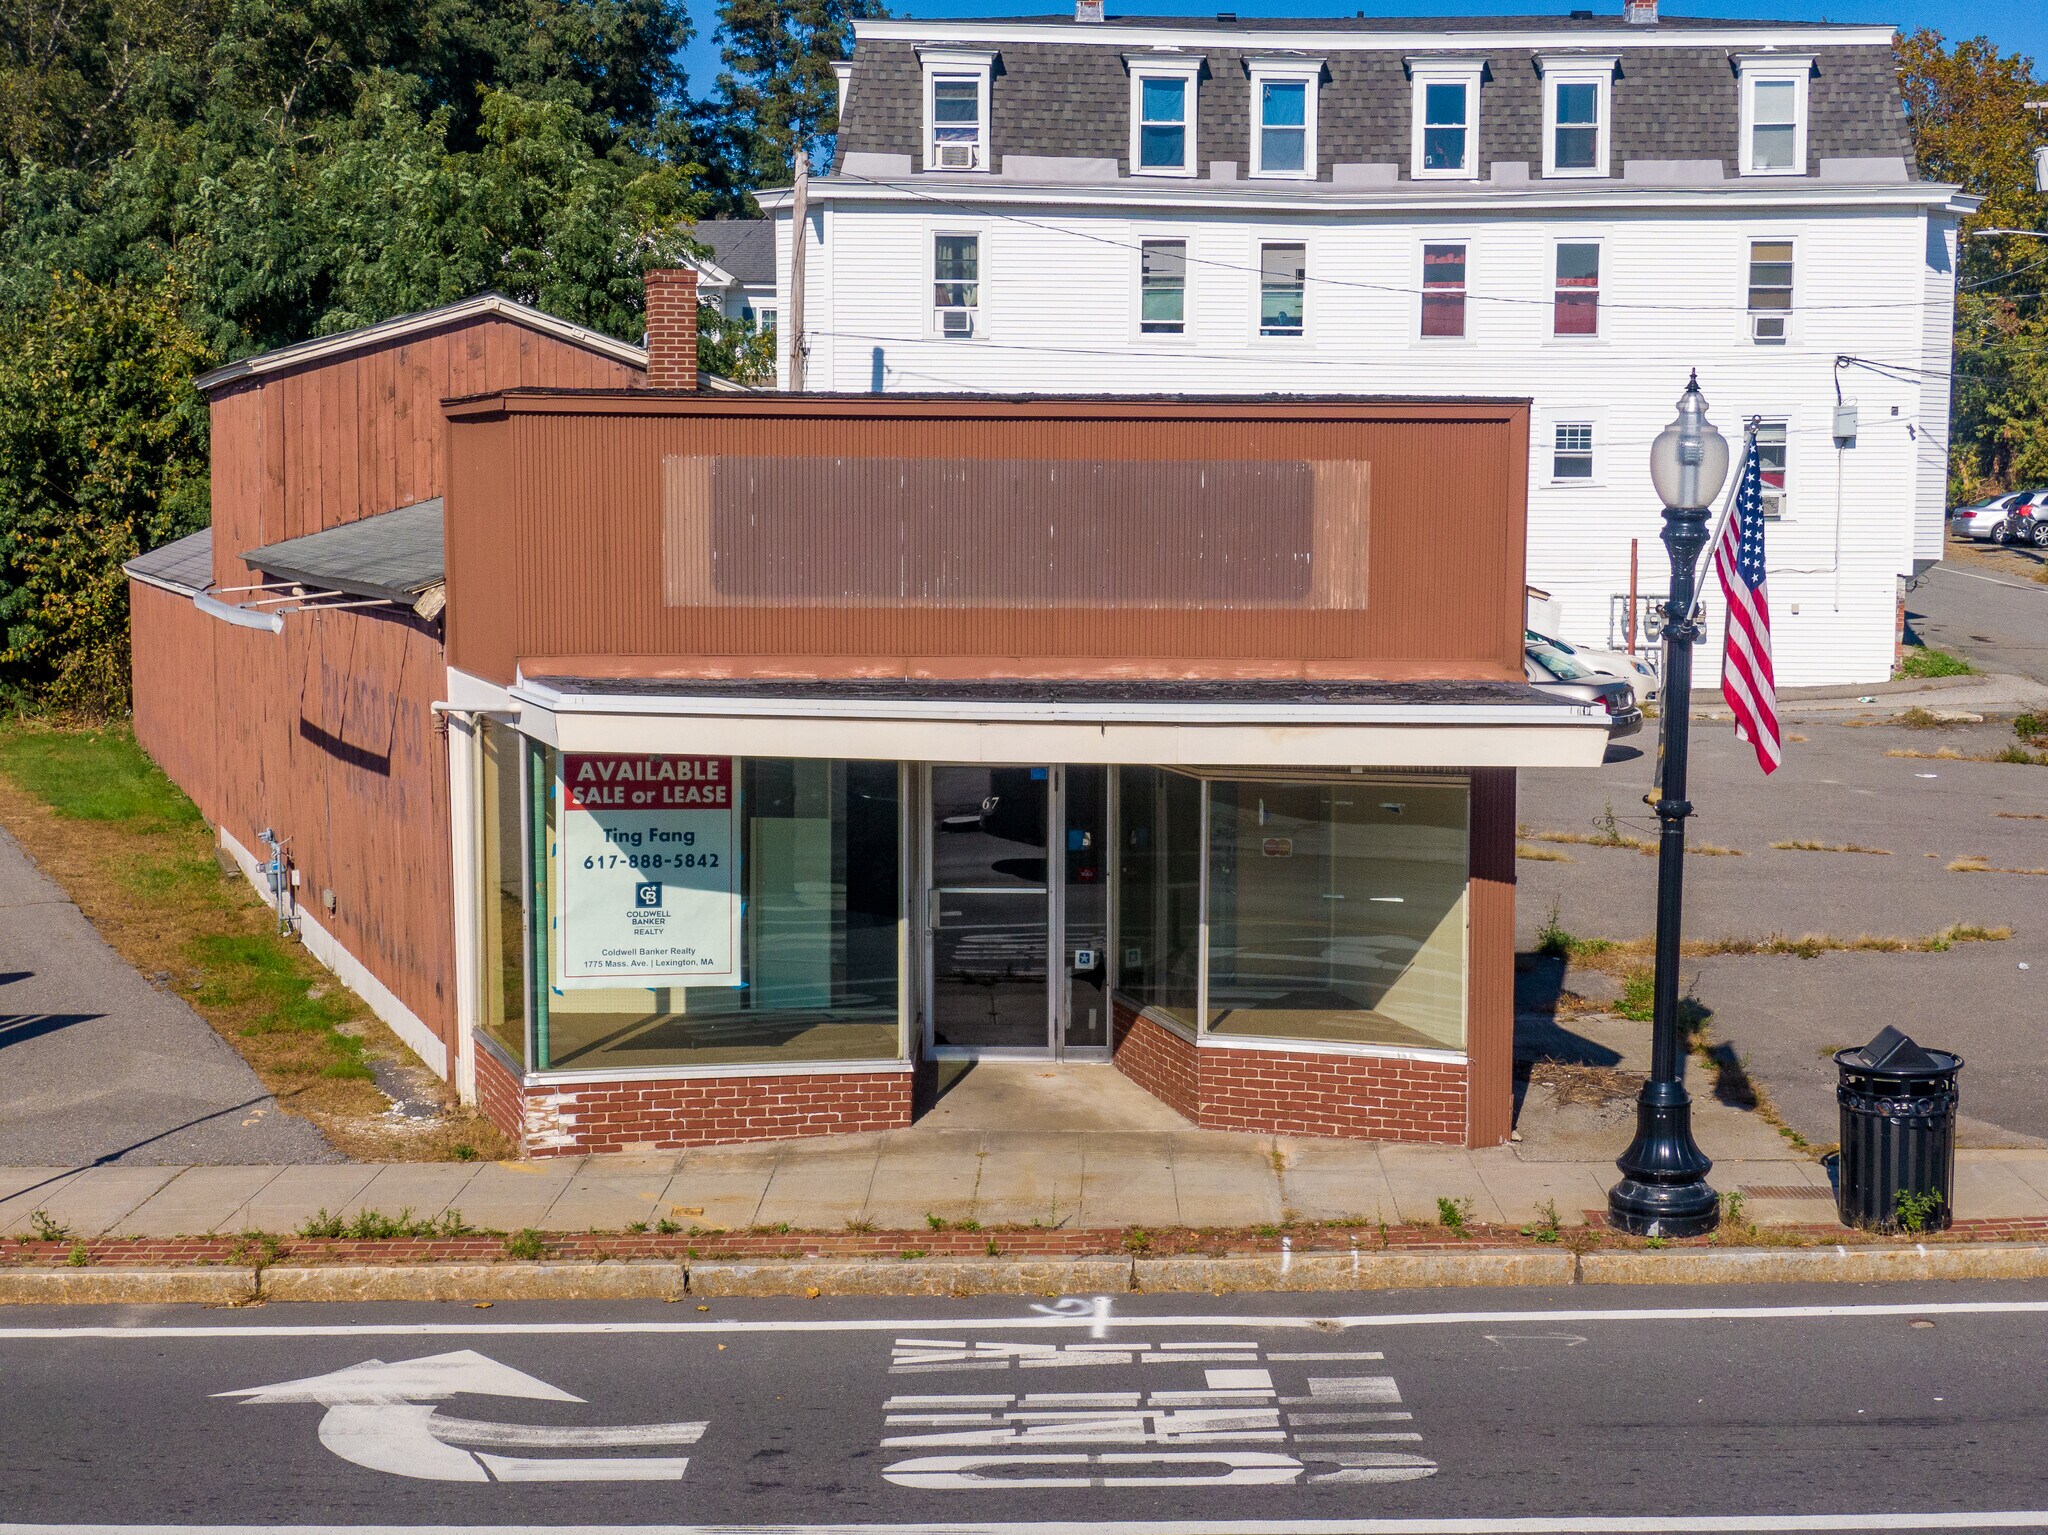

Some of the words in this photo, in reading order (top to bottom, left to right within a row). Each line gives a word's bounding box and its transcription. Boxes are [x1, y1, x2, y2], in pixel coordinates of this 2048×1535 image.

[577, 761, 719, 782] AVAILABLE
[572, 786, 625, 804] SALE
[631, 791, 656, 804] or
[663, 785, 727, 803] LEASE
[982, 796, 1000, 810] 67
[603, 828, 642, 847] Ting
[649, 828, 695, 846] Fang
[583, 853, 719, 870] 617-888-5842
[626, 910, 671, 918] COLDWELL
[601, 948, 637, 956] Coldwell
[639, 947, 668, 956] Banker
[670, 947, 696, 956] Realty
[605, 960, 629, 968] Mass.
[631, 960, 649, 968] Ave.
[655, 958, 699, 967] Lexington,
[700, 958, 714, 966] MA
